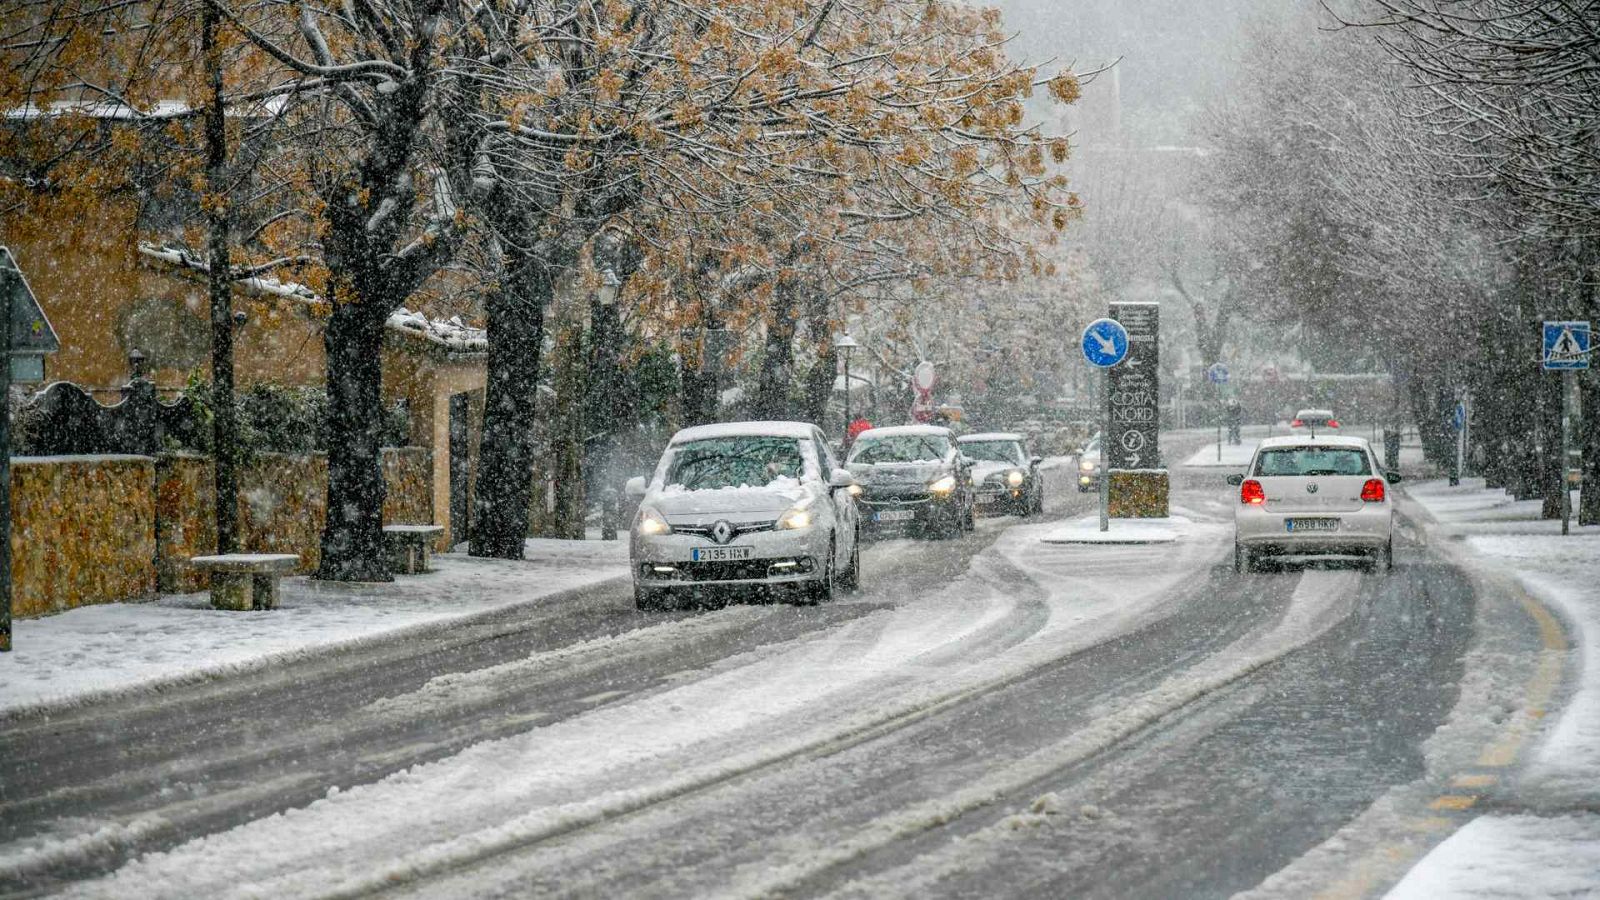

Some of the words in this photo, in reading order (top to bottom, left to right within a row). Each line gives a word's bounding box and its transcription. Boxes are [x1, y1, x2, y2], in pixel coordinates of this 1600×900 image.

[1112, 391, 1153, 406] COSTA
[1112, 406, 1154, 421] NORD
[700, 549, 727, 560] 2135
